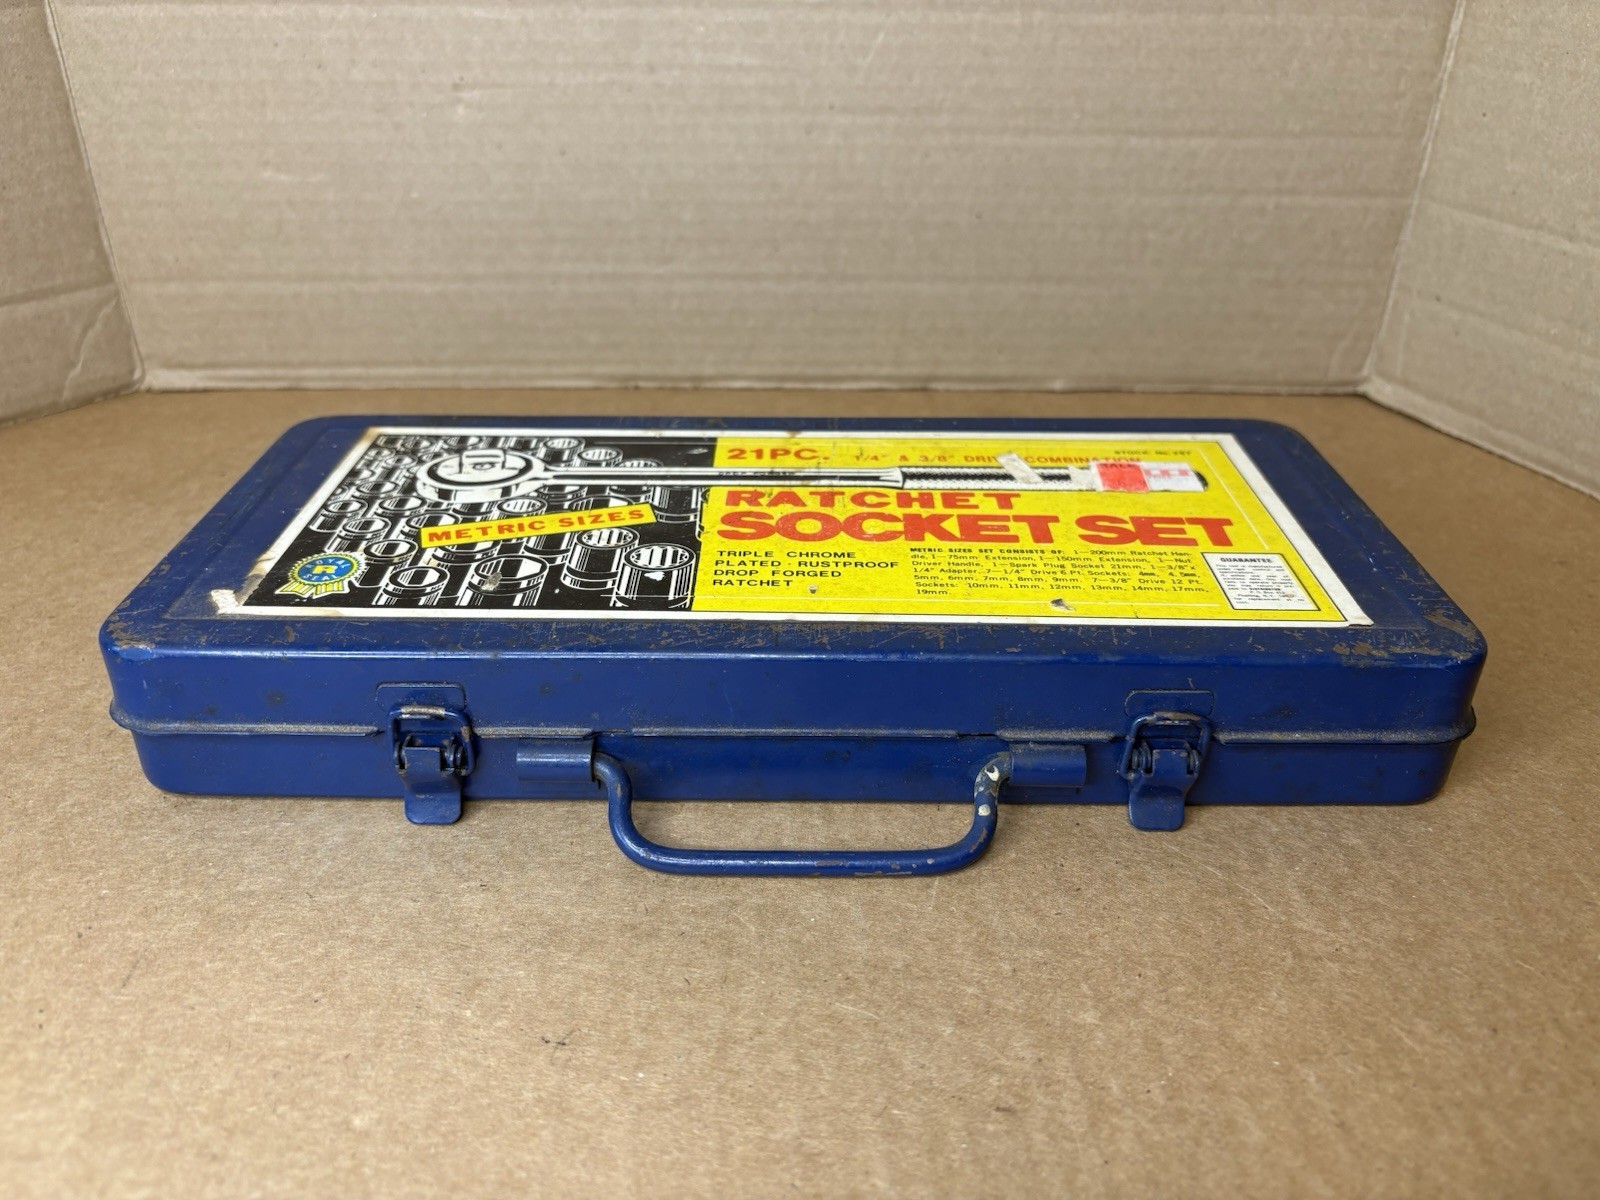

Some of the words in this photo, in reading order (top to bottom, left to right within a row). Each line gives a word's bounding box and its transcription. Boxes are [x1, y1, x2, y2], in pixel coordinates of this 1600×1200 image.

[728, 448, 830, 460] 21PC.
[725, 490, 1022, 510] RATCHET
[428, 520, 546, 542] METRIC
[558, 509, 646, 528] SIZES
[717, 511, 1060, 544] SOCKET
[1075, 516, 1234, 547] SET
[305, 558, 350, 568] ROYAL
[798, 560, 899, 568] RUSTPROOF
